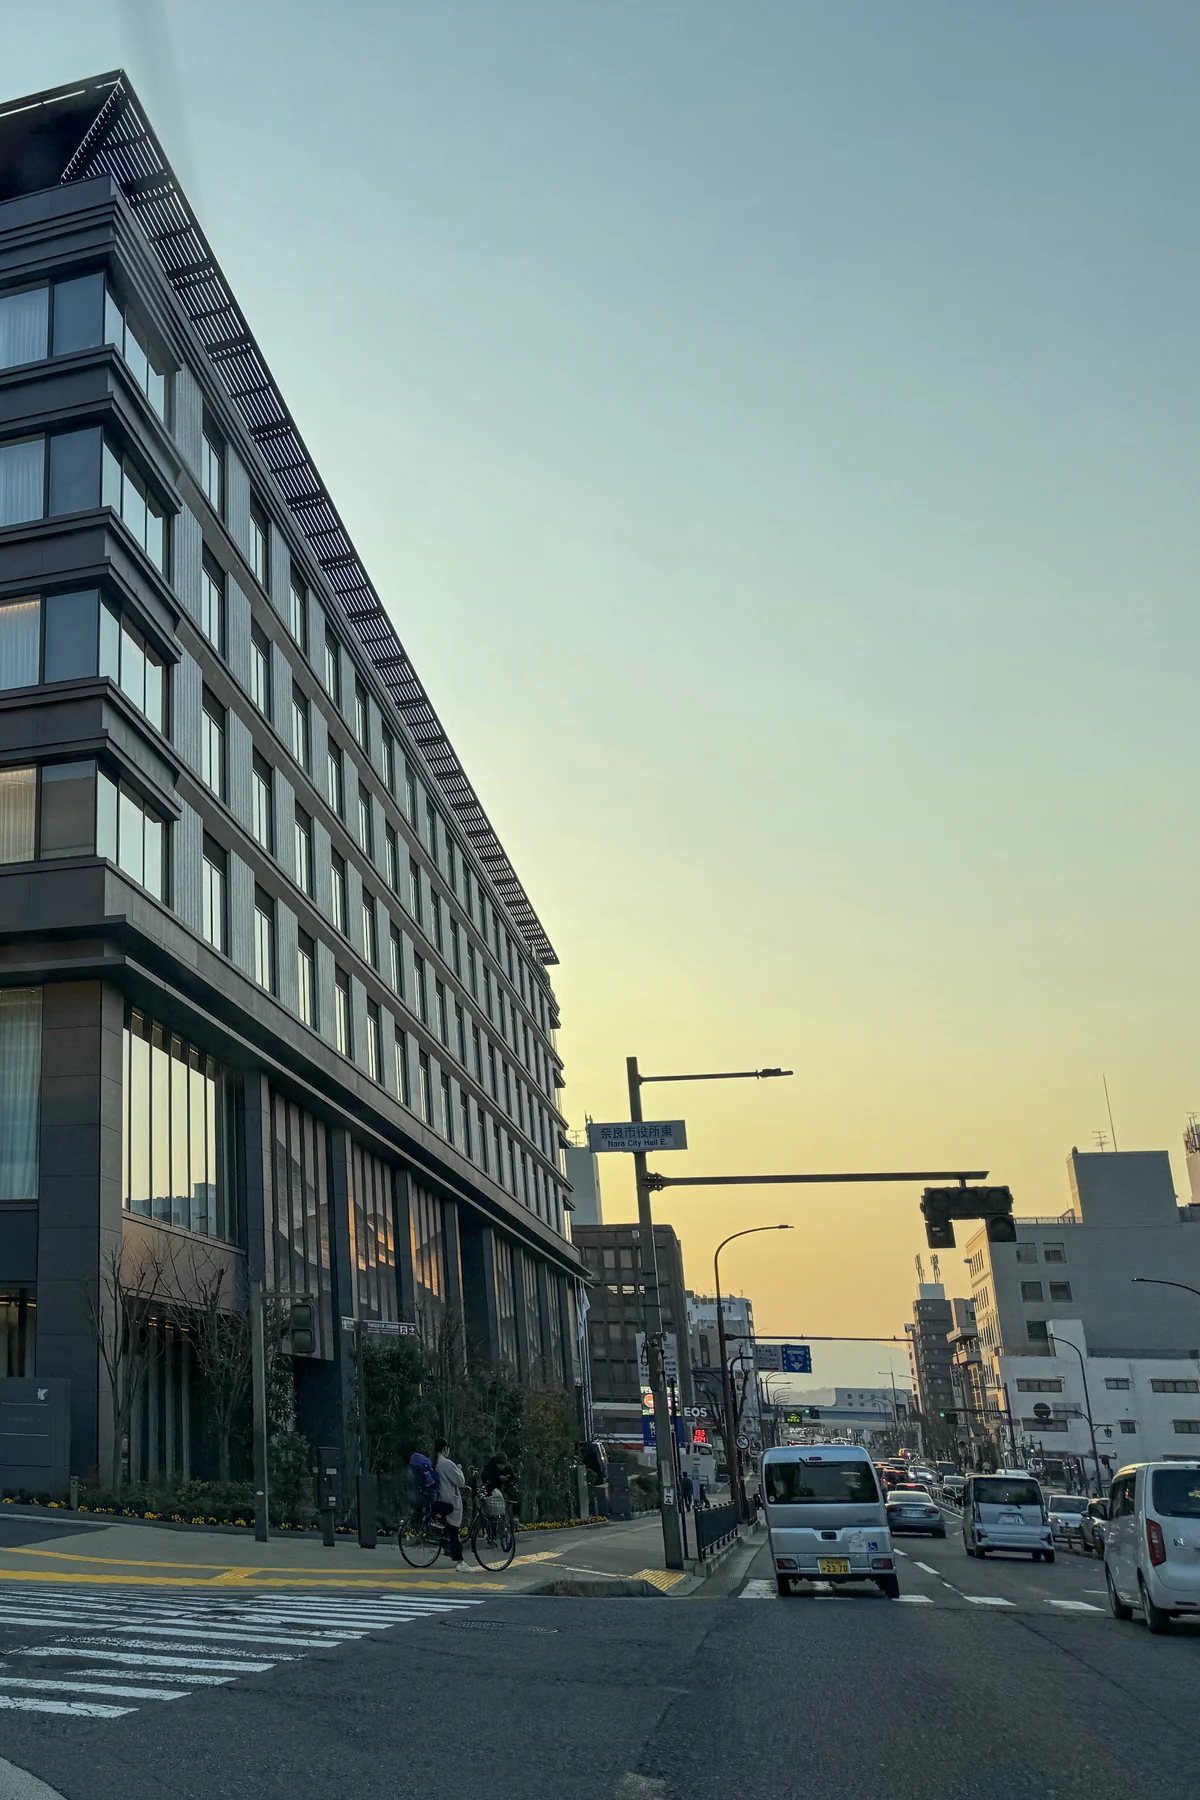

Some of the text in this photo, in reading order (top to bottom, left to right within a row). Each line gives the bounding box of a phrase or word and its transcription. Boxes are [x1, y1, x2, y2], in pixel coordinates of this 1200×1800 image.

[600, 1125, 673, 1140] 奈良市役所東
[607, 1140, 625, 1148] Nara
[628, 1139, 642, 1148] City
